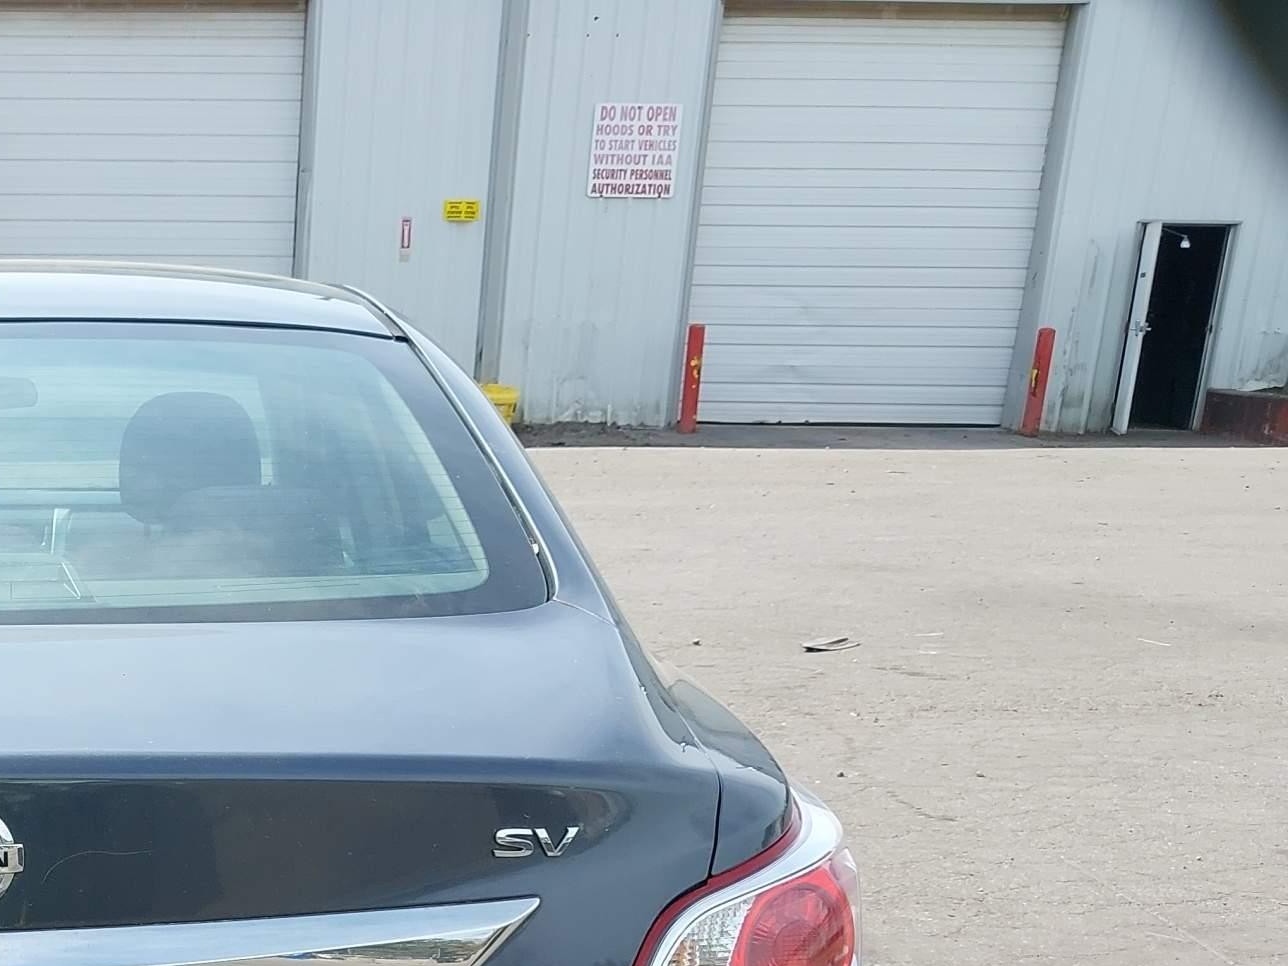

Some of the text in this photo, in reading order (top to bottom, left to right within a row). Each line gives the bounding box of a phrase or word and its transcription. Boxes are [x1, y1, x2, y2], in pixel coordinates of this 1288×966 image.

[600, 105, 678, 121] DO NOT OPEN
[596, 124, 678, 136] HOODS OR TRY
[594, 139, 678, 151] TO START VEHICLES
[593, 153, 672, 166] WITHOUT IAA
[592, 168, 672, 180] SECURITY PERSONNEL
[590, 183, 671, 195] AUTHORIZATION
[493, 826, 579, 857] SV
